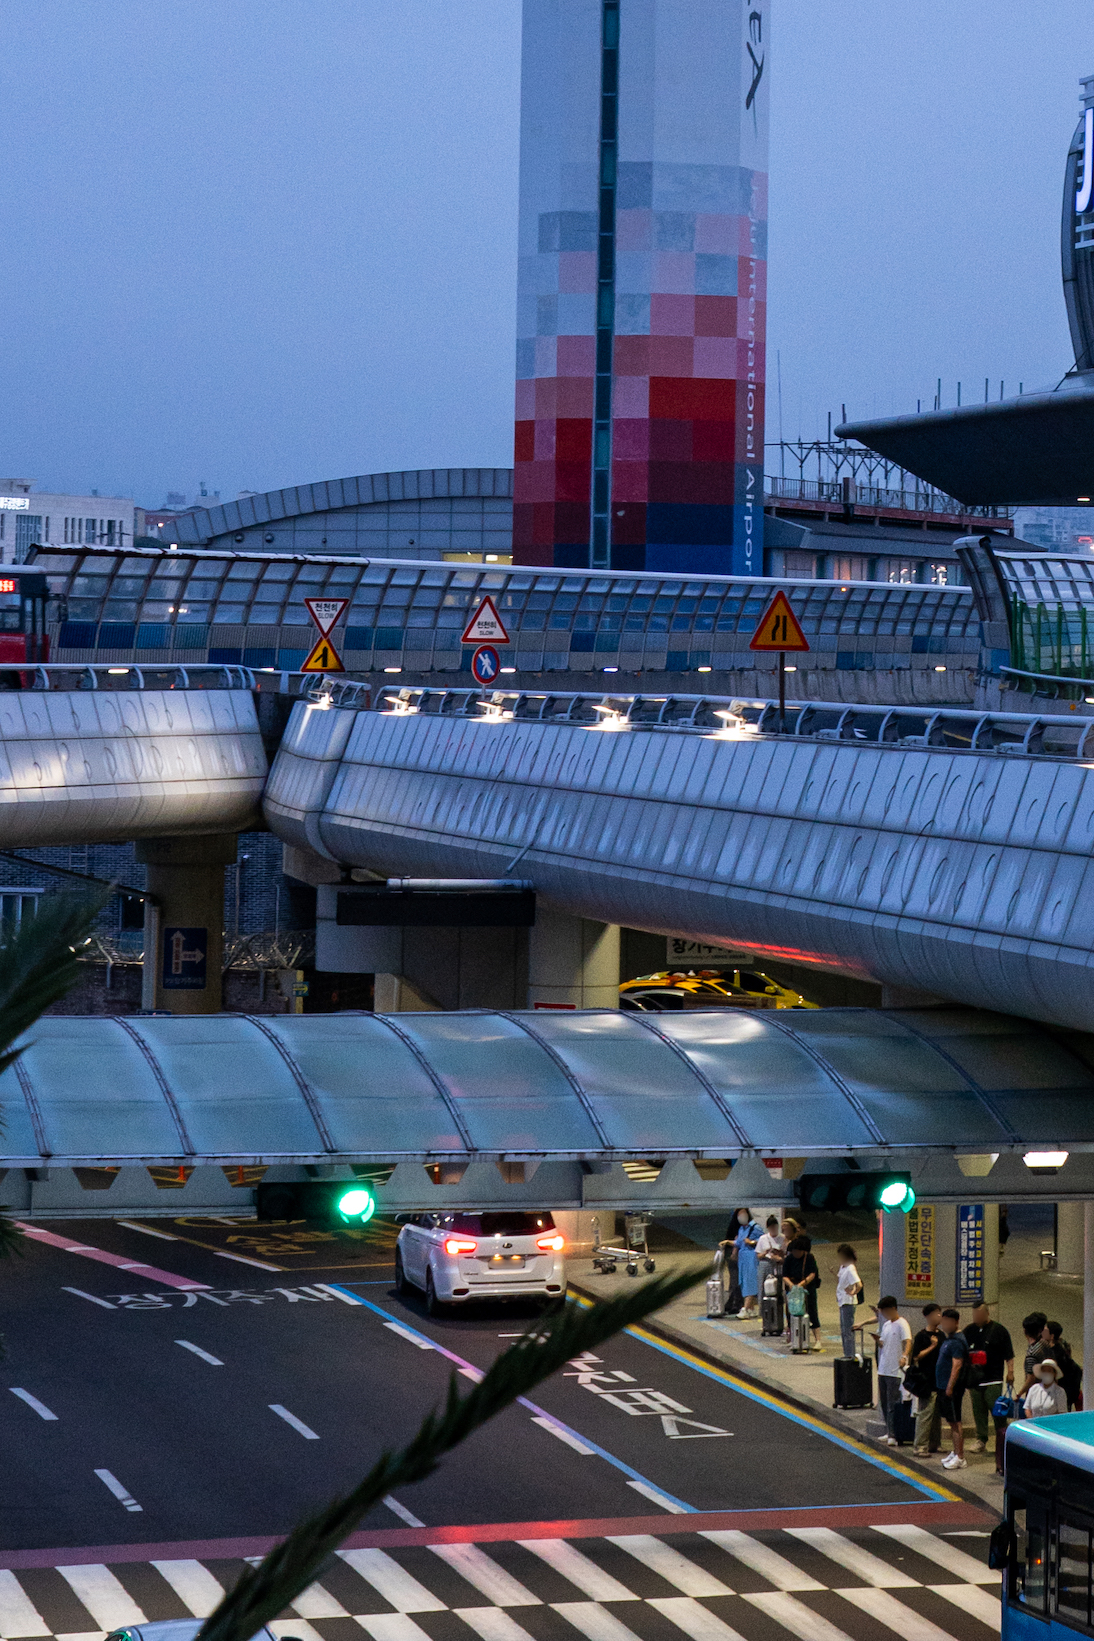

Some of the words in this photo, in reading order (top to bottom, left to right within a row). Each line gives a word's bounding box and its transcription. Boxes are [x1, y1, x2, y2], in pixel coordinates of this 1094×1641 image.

[746, 252, 758, 458] International
[743, 468, 756, 572] Airpor
[315, 603, 338, 612] 천천히
[477, 620, 497, 629] 천천히
[908, 1207, 919, 1273] 불법주정차
[920, 1207, 932, 1273] 무인단속중
[106, 1287, 334, 1310] 장기주차
